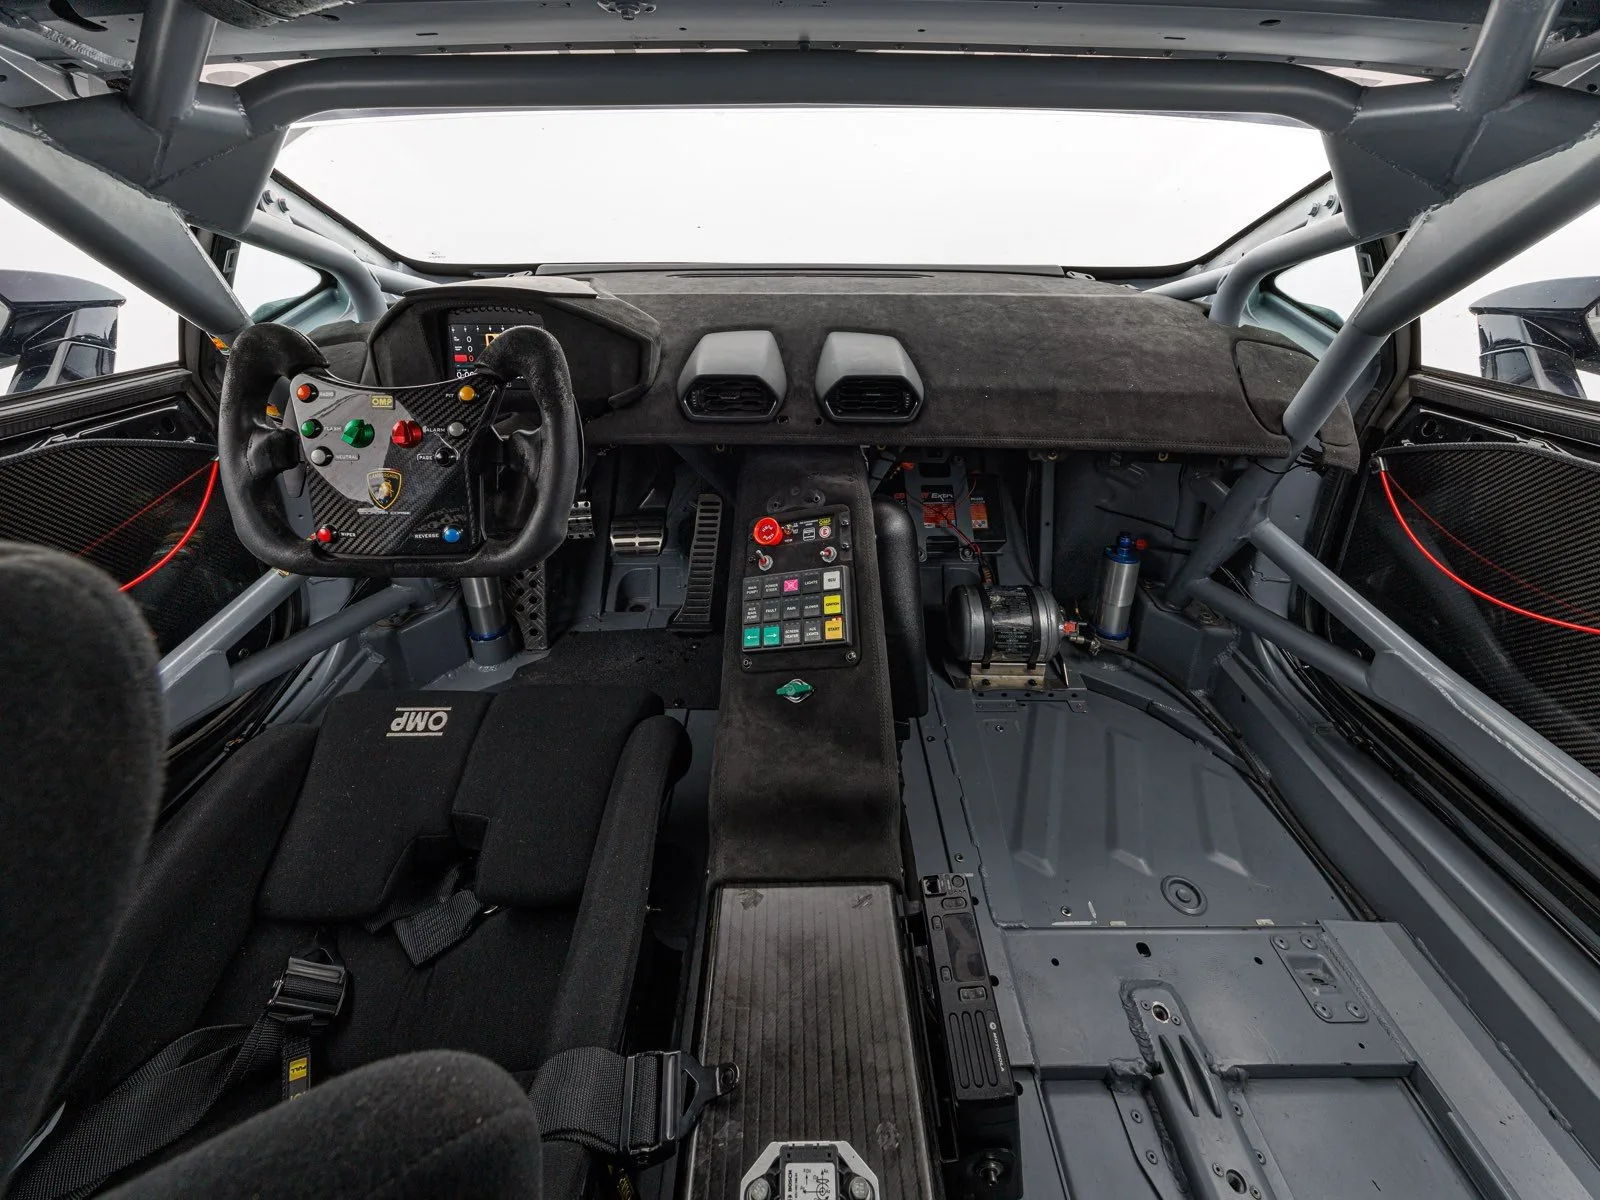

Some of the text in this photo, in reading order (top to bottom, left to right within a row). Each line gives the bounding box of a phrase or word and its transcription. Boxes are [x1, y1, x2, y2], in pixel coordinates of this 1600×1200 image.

[371, 398, 393, 406] OMP
[390, 711, 448, 732] OMP
[992, 1032, 1005, 1072] MOTOROLA
[291, 1065, 306, 1073] PULL
